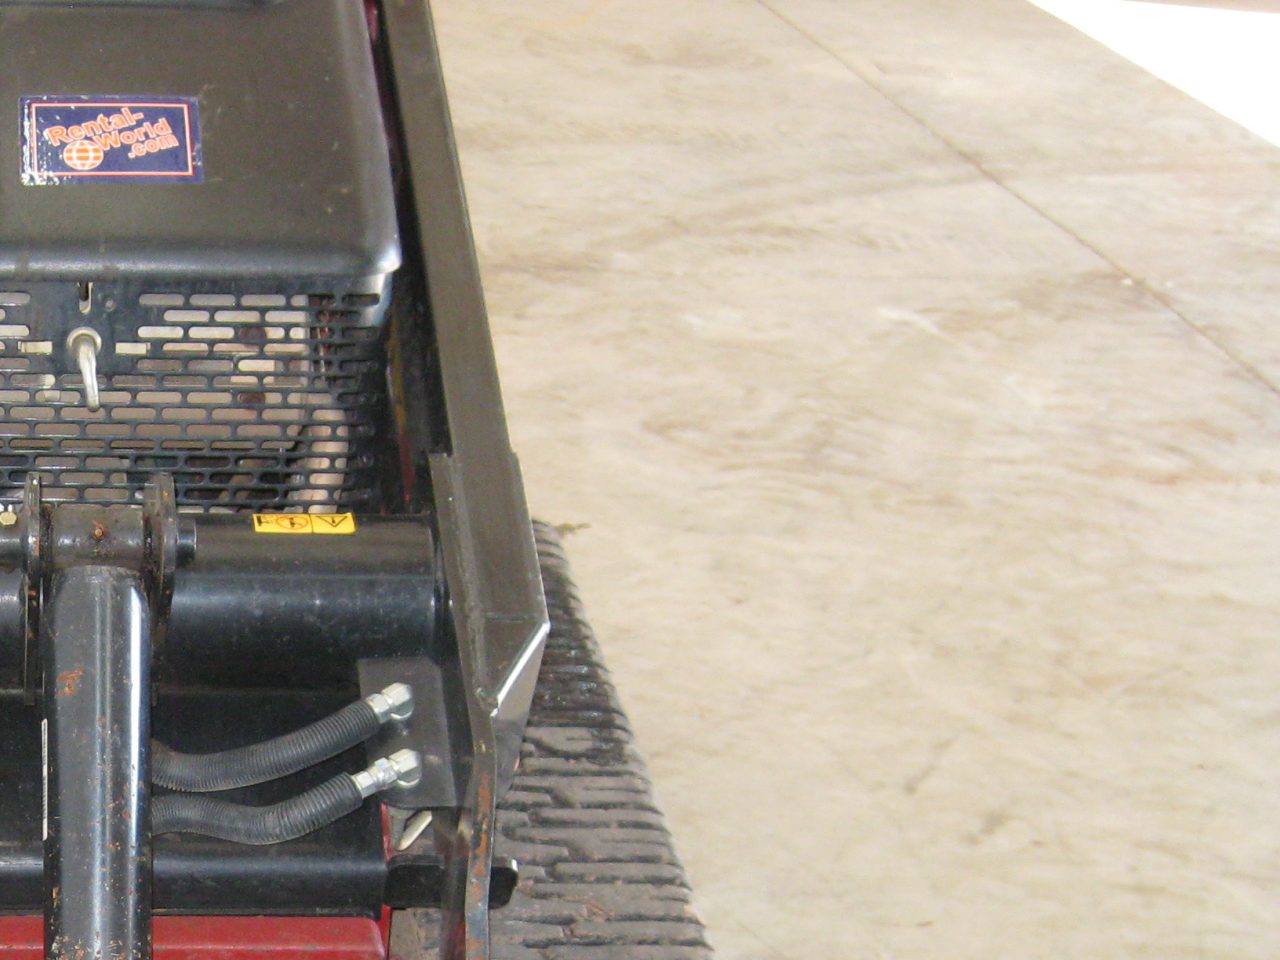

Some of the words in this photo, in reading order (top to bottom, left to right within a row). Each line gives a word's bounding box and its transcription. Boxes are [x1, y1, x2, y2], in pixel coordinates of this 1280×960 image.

[45, 107, 144, 146] Rental-
[93, 117, 172, 151] World
[128, 133, 179, 159] .com
